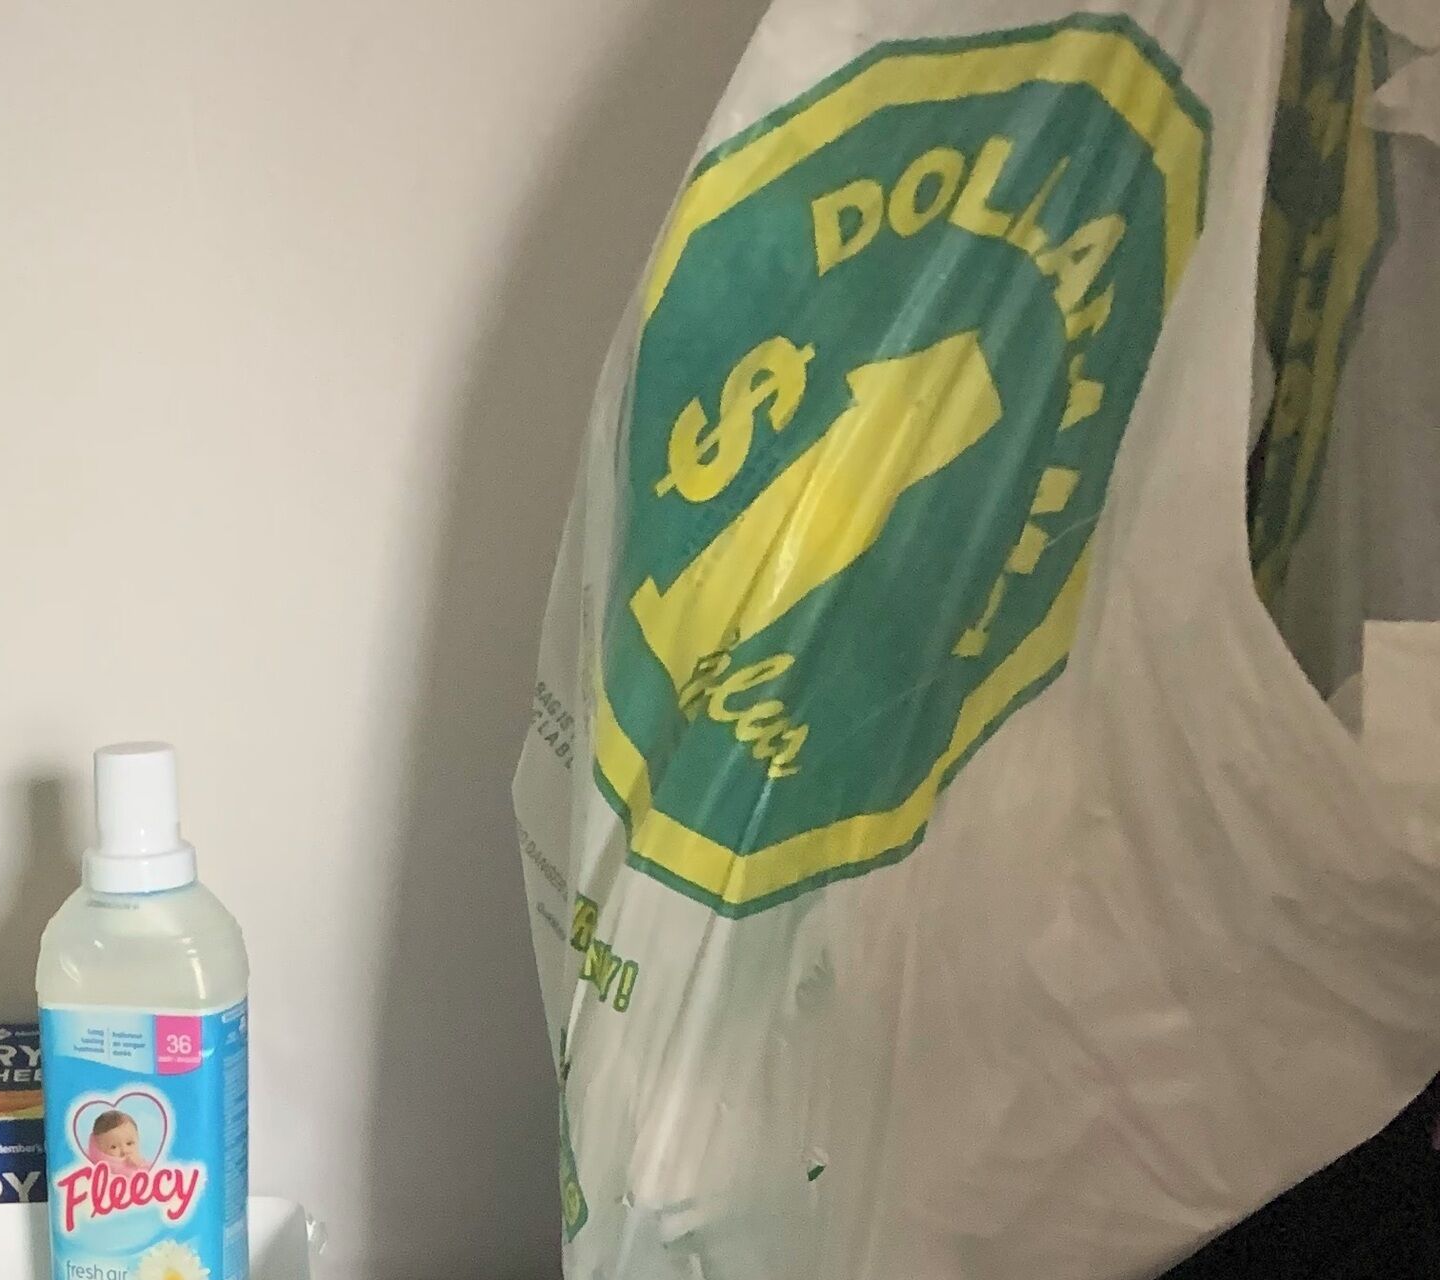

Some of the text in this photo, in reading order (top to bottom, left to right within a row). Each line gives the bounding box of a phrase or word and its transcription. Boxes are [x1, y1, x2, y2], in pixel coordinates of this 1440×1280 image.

[166, 1033, 193, 1055] 36
[57, 1160, 199, 1234] Fleecy
[66, 1259, 104, 1280] fresh
